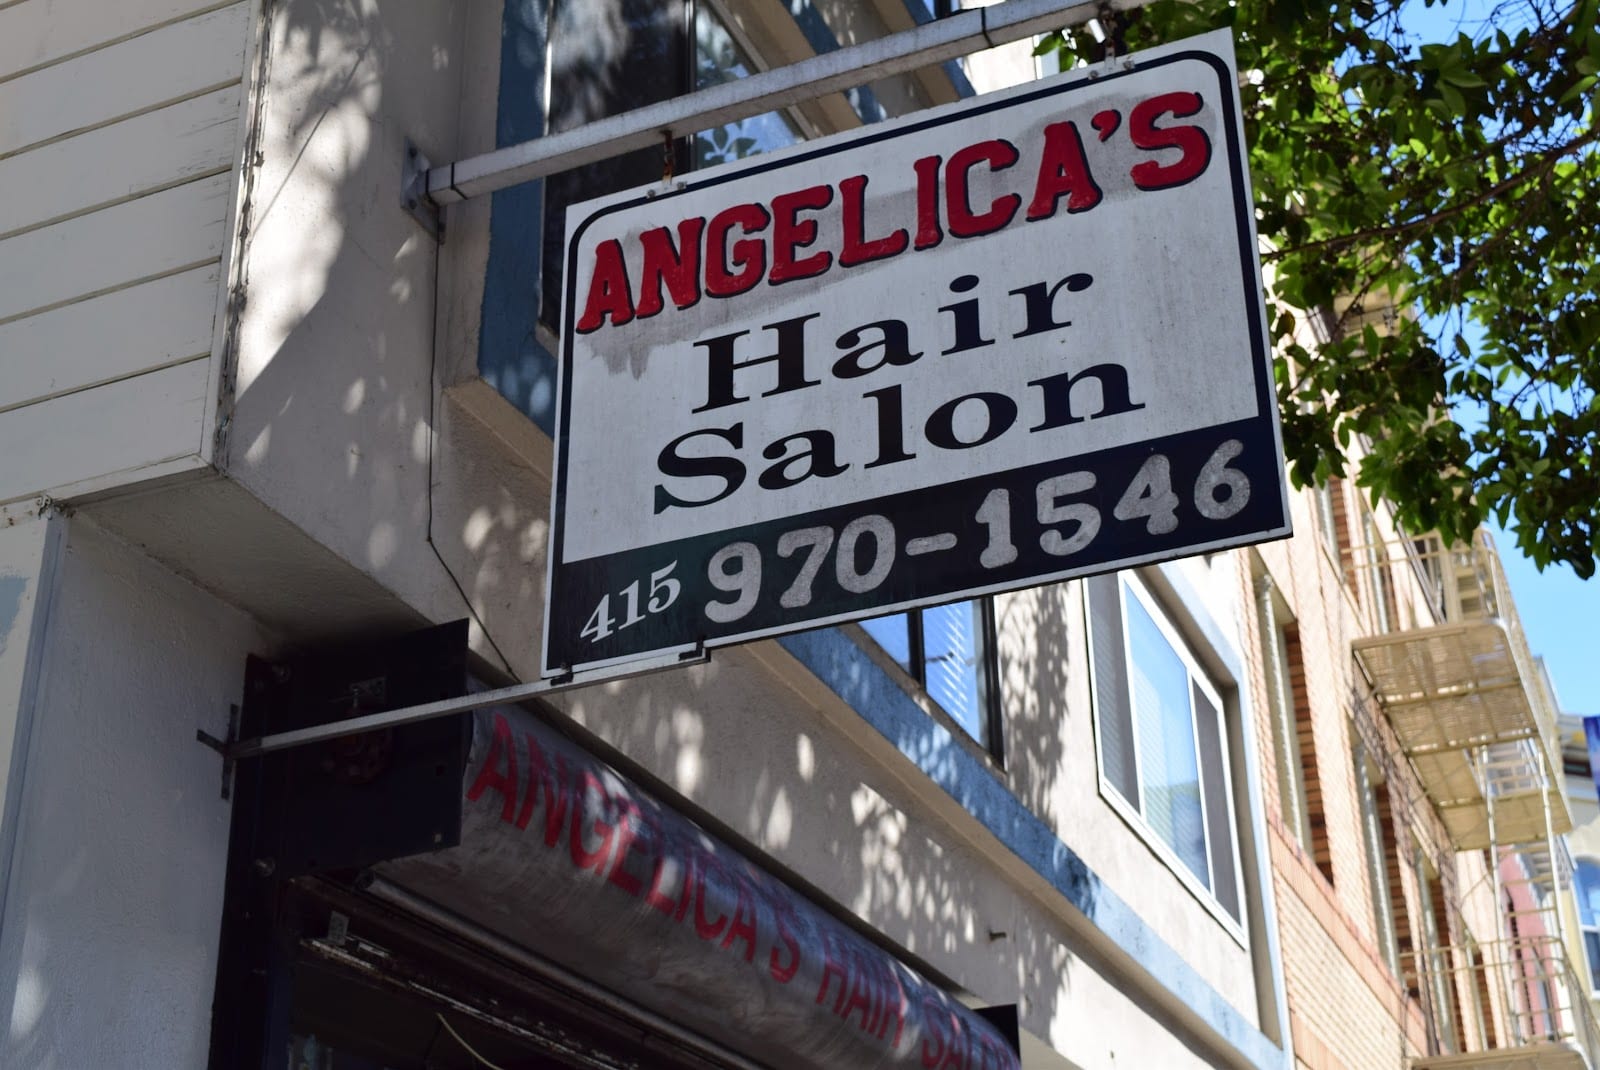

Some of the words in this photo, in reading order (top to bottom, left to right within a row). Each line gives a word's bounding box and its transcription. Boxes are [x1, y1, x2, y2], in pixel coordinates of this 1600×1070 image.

[576, 91, 1212, 334] ANGELICA'S
[691, 272, 1094, 414] Hair
[653, 361, 1146, 515] Salon
[579, 559, 681, 643] 415
[704, 438, 1252, 624] 970-1546
[815, 927, 905, 1049] HAIR
